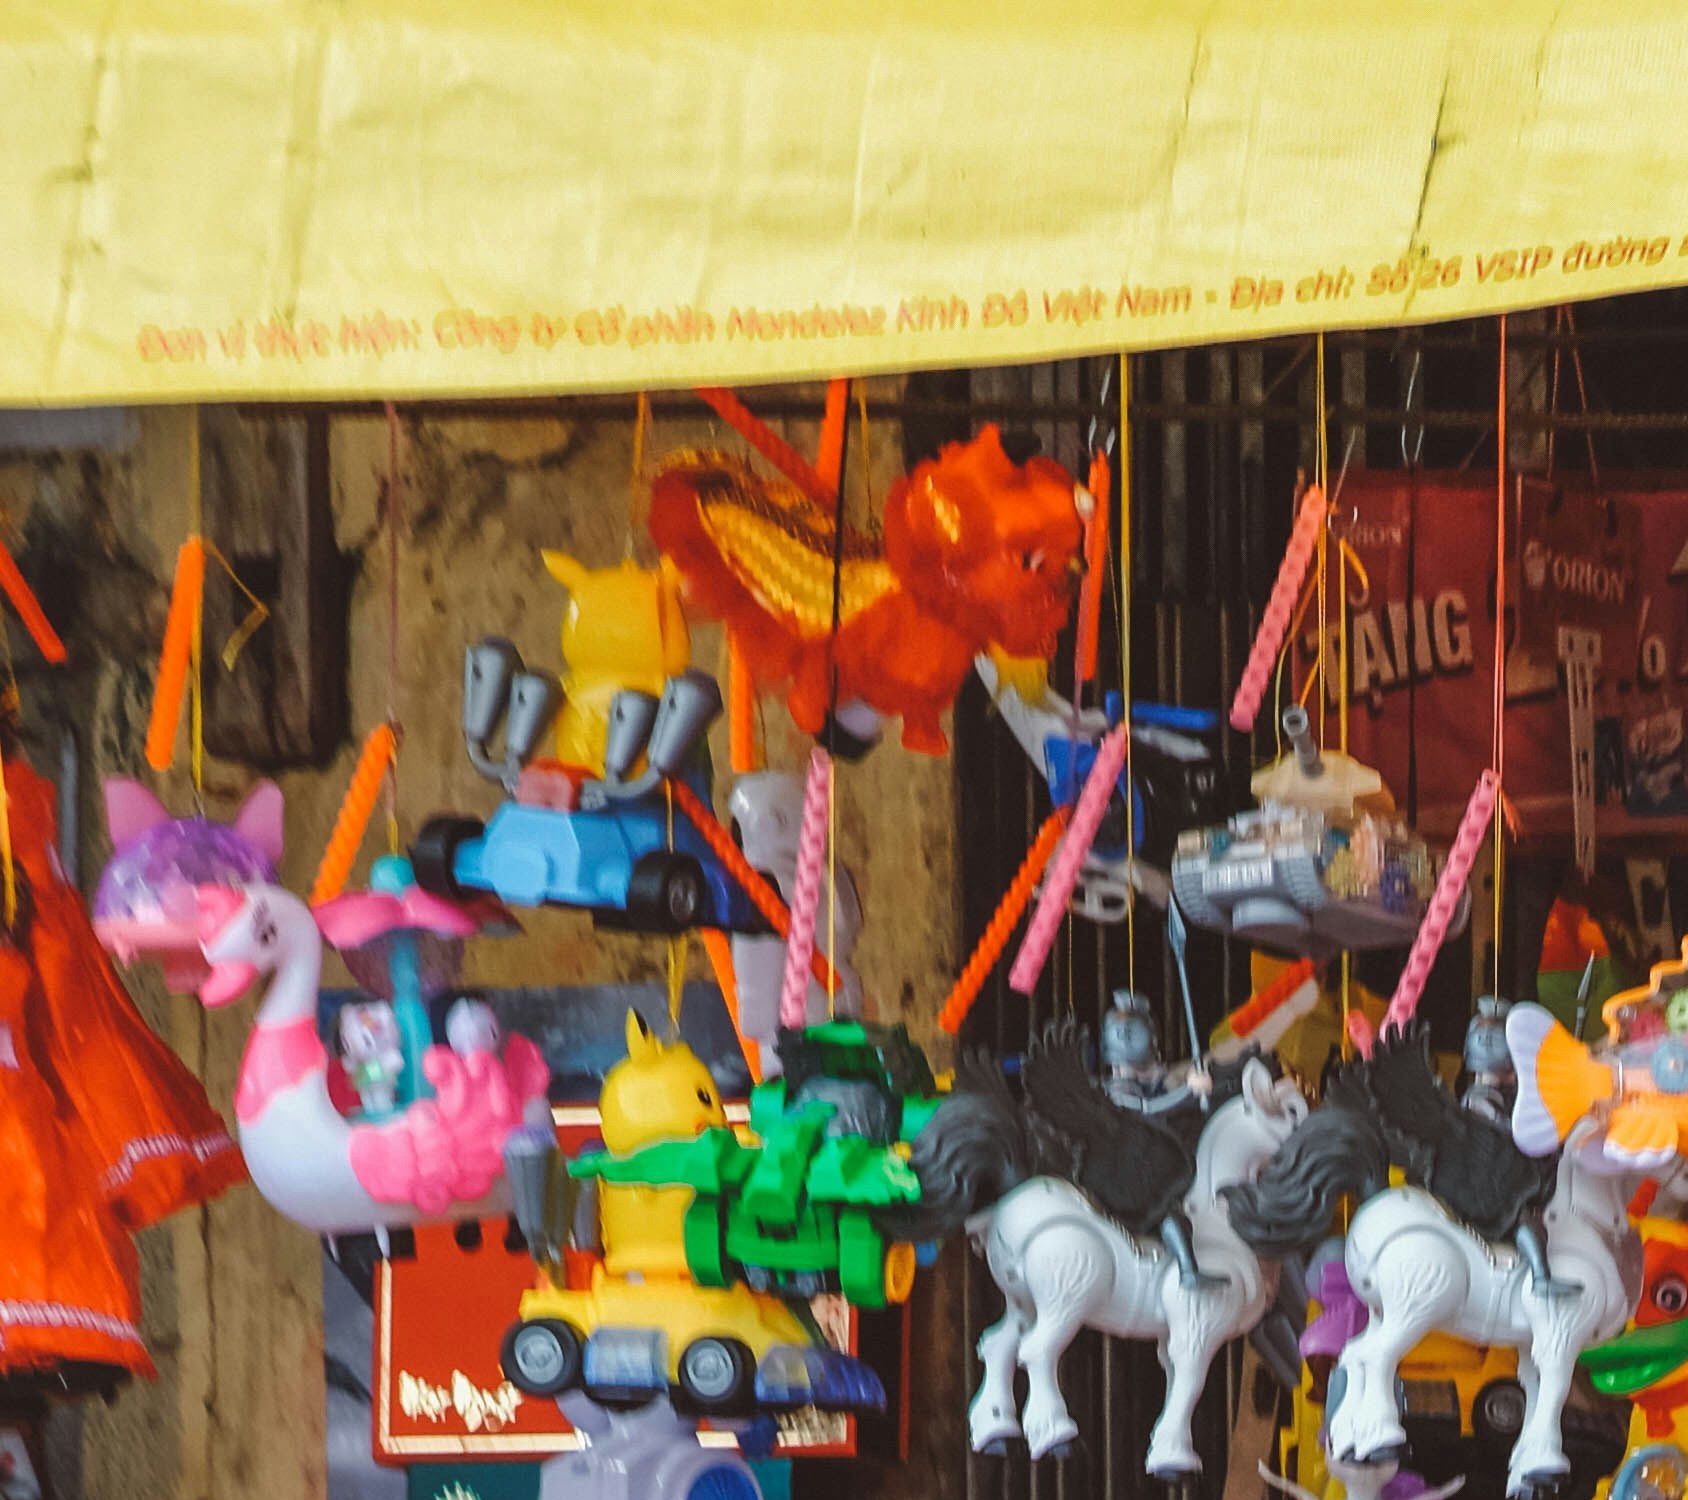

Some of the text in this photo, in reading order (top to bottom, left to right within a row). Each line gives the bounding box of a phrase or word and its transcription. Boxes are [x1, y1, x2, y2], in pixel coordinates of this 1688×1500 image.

[726, 300, 886, 342] Mondelez
[897, 292, 968, 334] Kinh
[983, 290, 1029, 327] Đô
[1043, 284, 1100, 328] Việt
[1115, 284, 1191, 319] Nam
[1230, 275, 1283, 313] Địa
[1474, 244, 1552, 283] VSIP
[1561, 233, 1669, 274] đường
[1552, 556, 1628, 602] ORION
